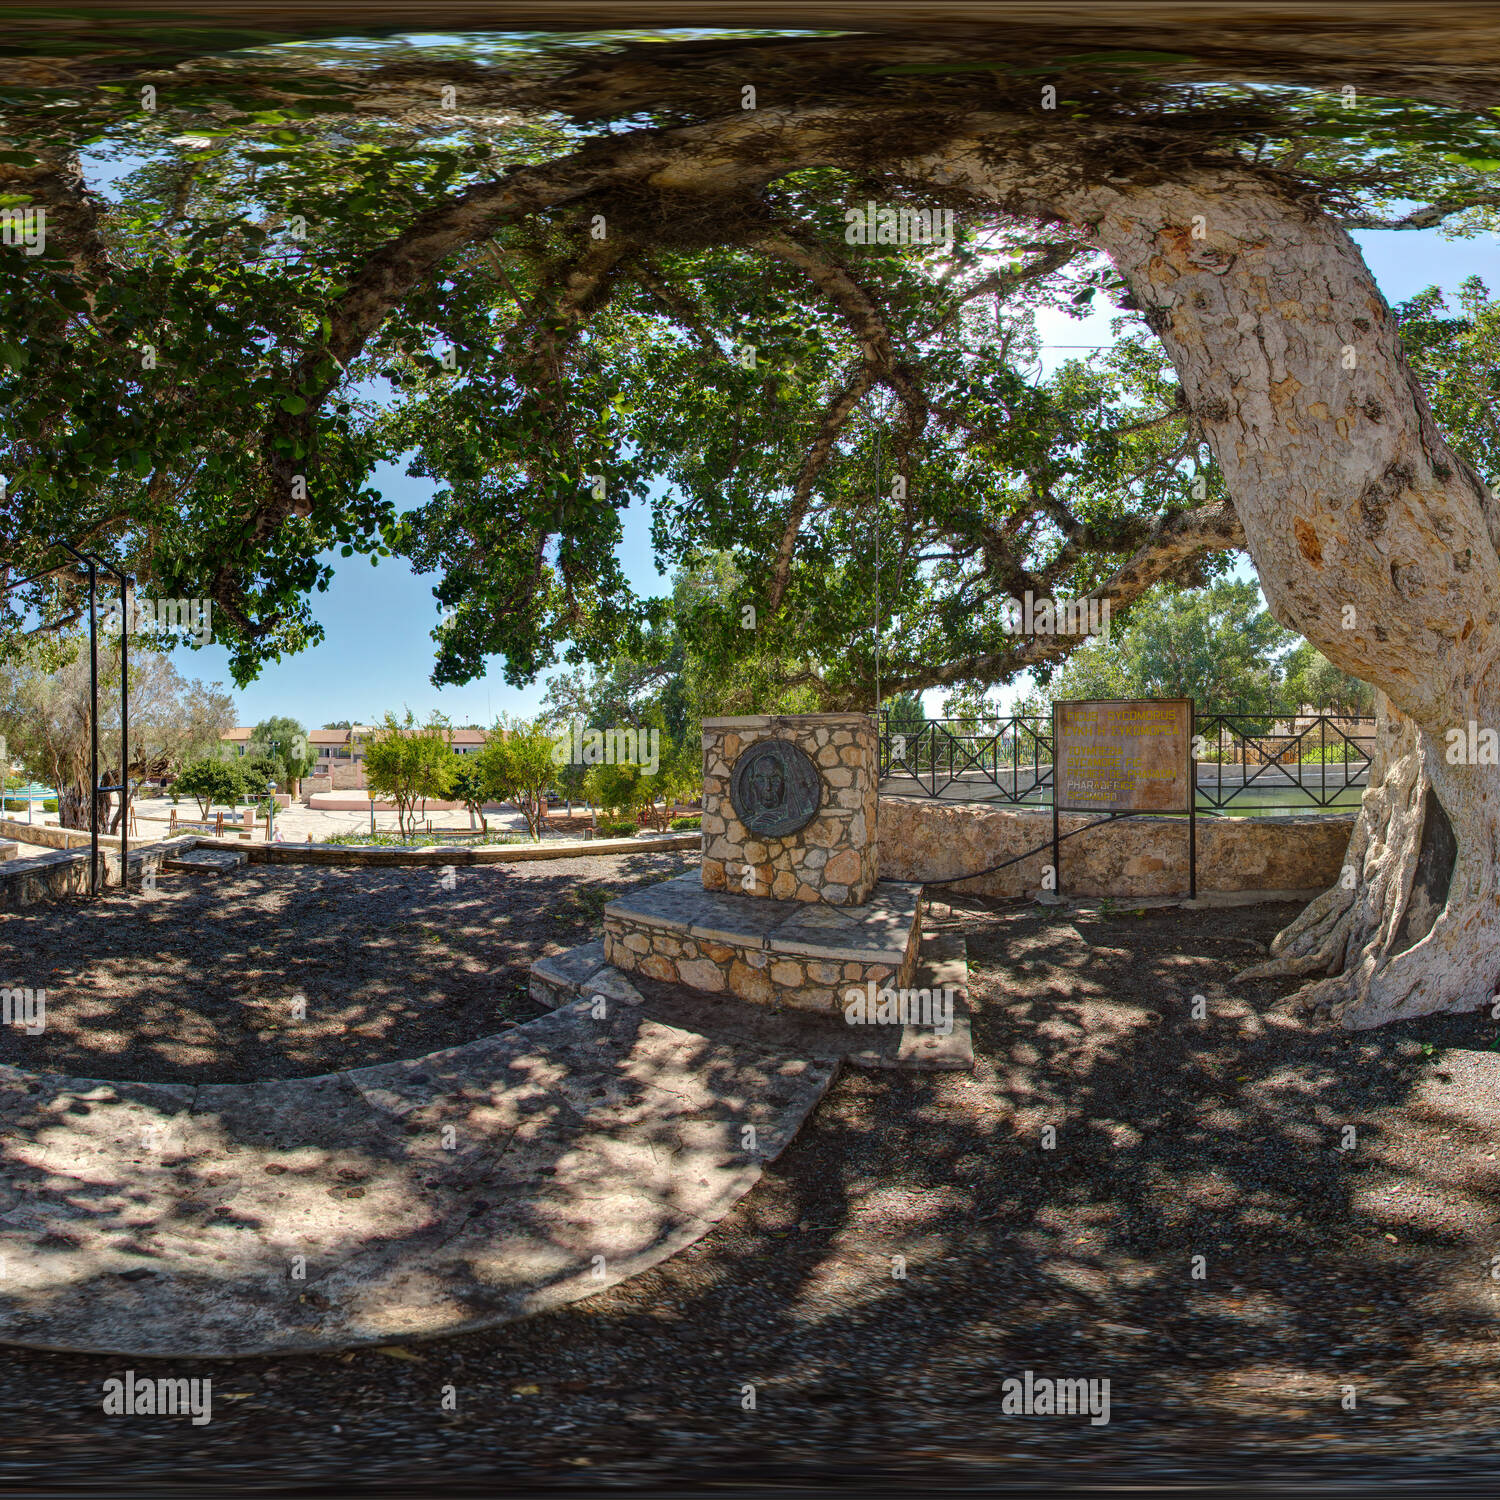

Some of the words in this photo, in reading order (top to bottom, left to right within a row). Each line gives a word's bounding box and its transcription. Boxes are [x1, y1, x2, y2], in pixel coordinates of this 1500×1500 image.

[1067, 712, 1098, 722] FICUS
[1108, 710, 1176, 720] SYCOMORUS
[1067, 758, 1121, 768] SYCAMORE
